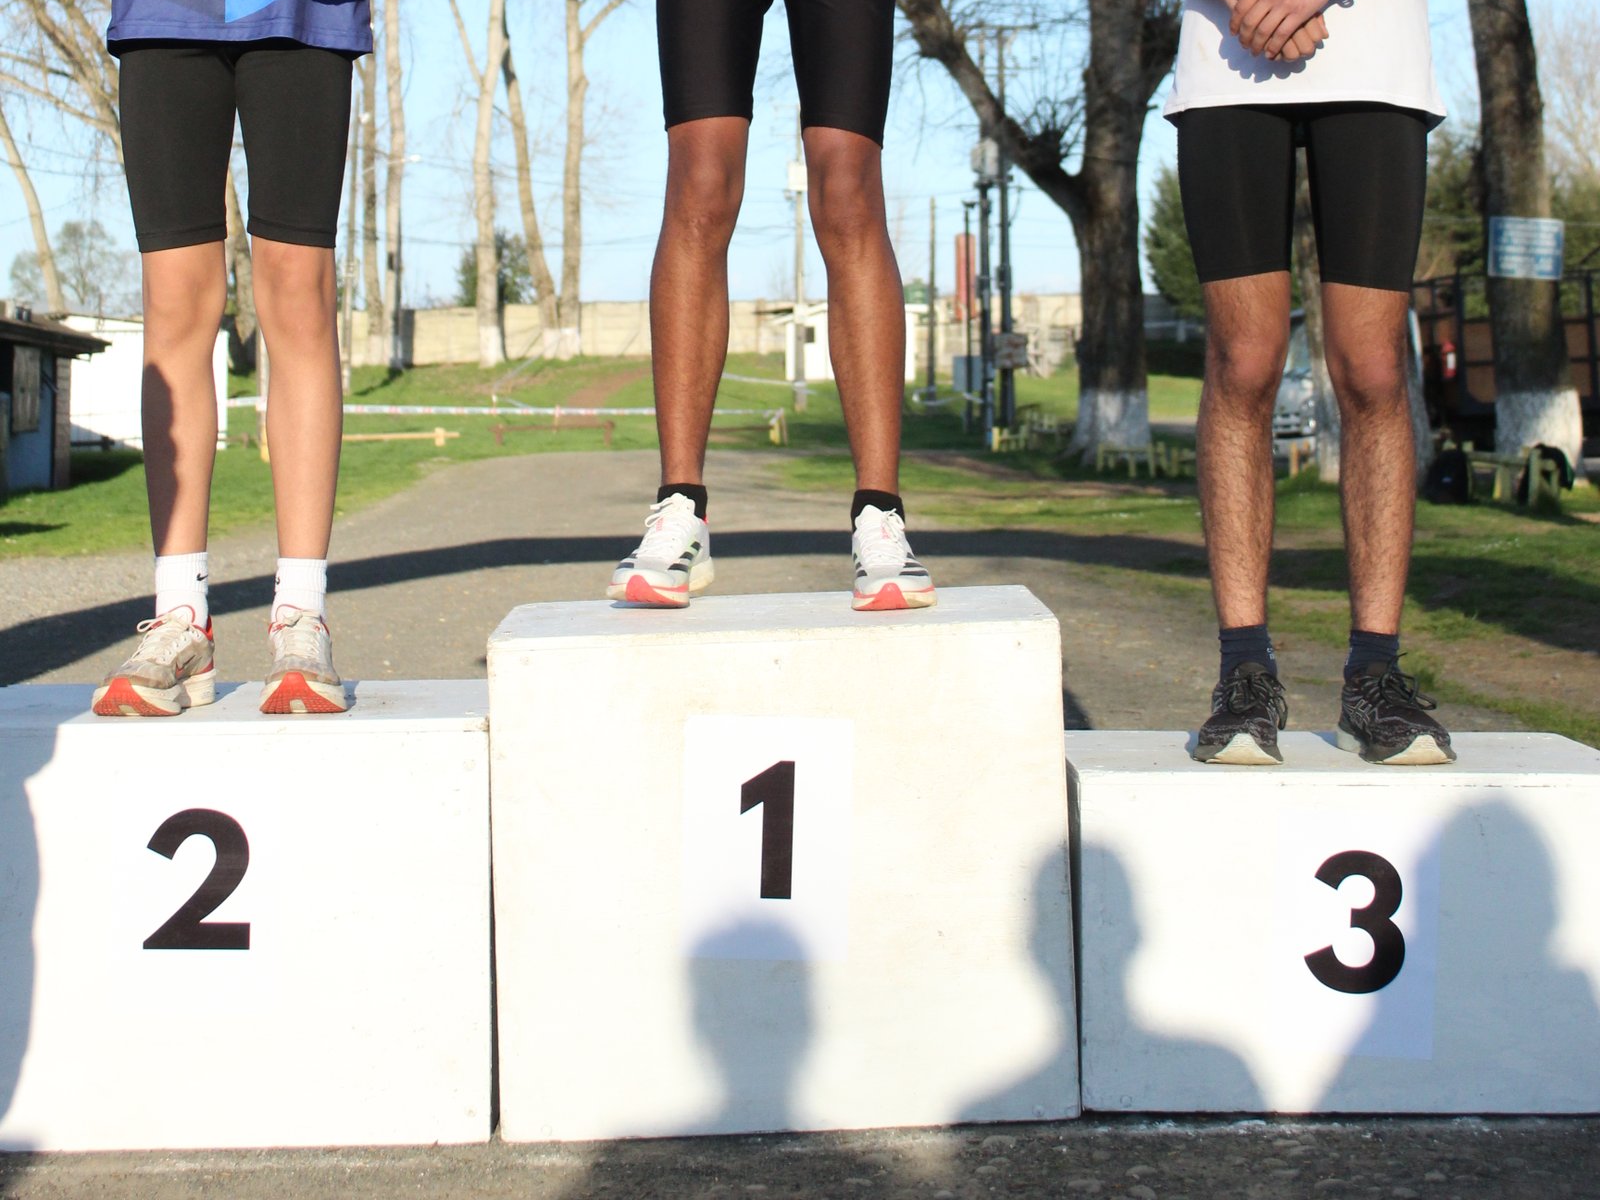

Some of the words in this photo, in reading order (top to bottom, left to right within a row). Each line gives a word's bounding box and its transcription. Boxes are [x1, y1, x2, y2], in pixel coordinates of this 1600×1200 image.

[143, 809, 250, 950] 2
[741, 761, 795, 900] 1
[1304, 851, 1406, 994] 3
